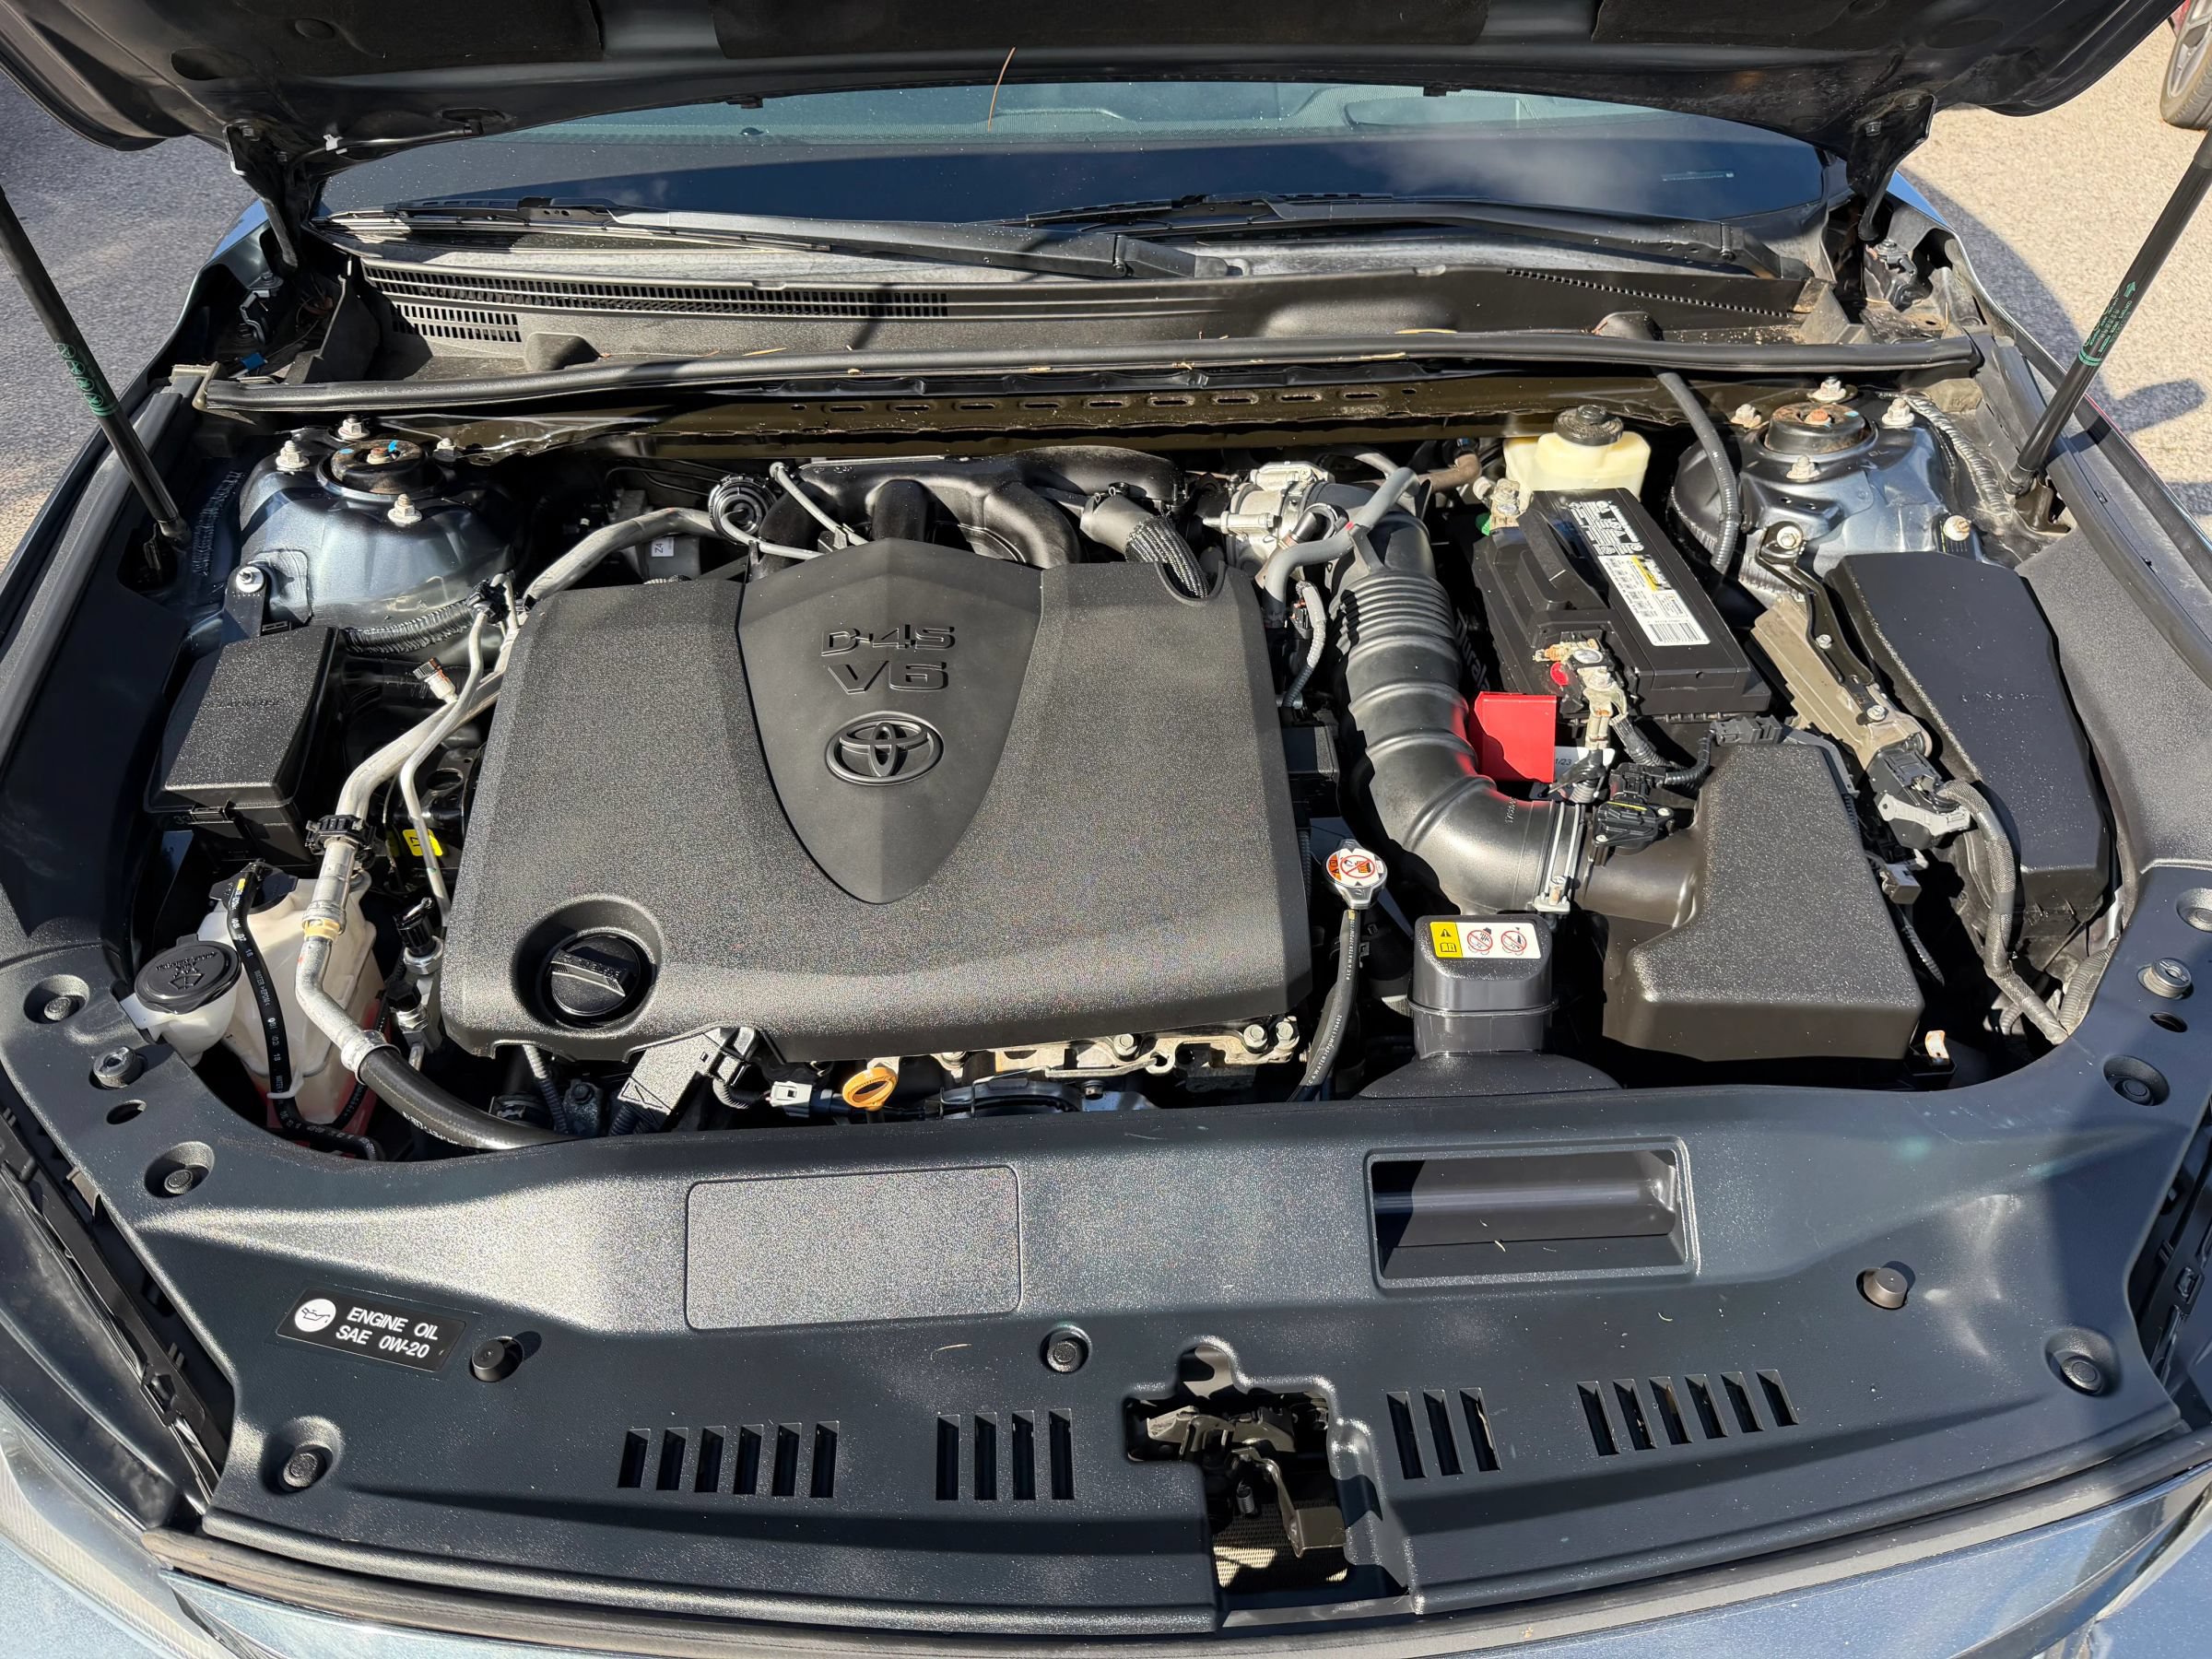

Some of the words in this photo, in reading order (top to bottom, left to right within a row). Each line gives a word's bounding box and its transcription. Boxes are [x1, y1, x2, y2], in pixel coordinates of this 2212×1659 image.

[821, 624, 956, 656] D-4S
[827, 661, 950, 694] V6
[347, 1307, 408, 1332] ENGINE
[414, 1322, 439, 1340] OIL
[335, 1324, 372, 1345] SAE
[379, 1335, 430, 1359] 0W-20
